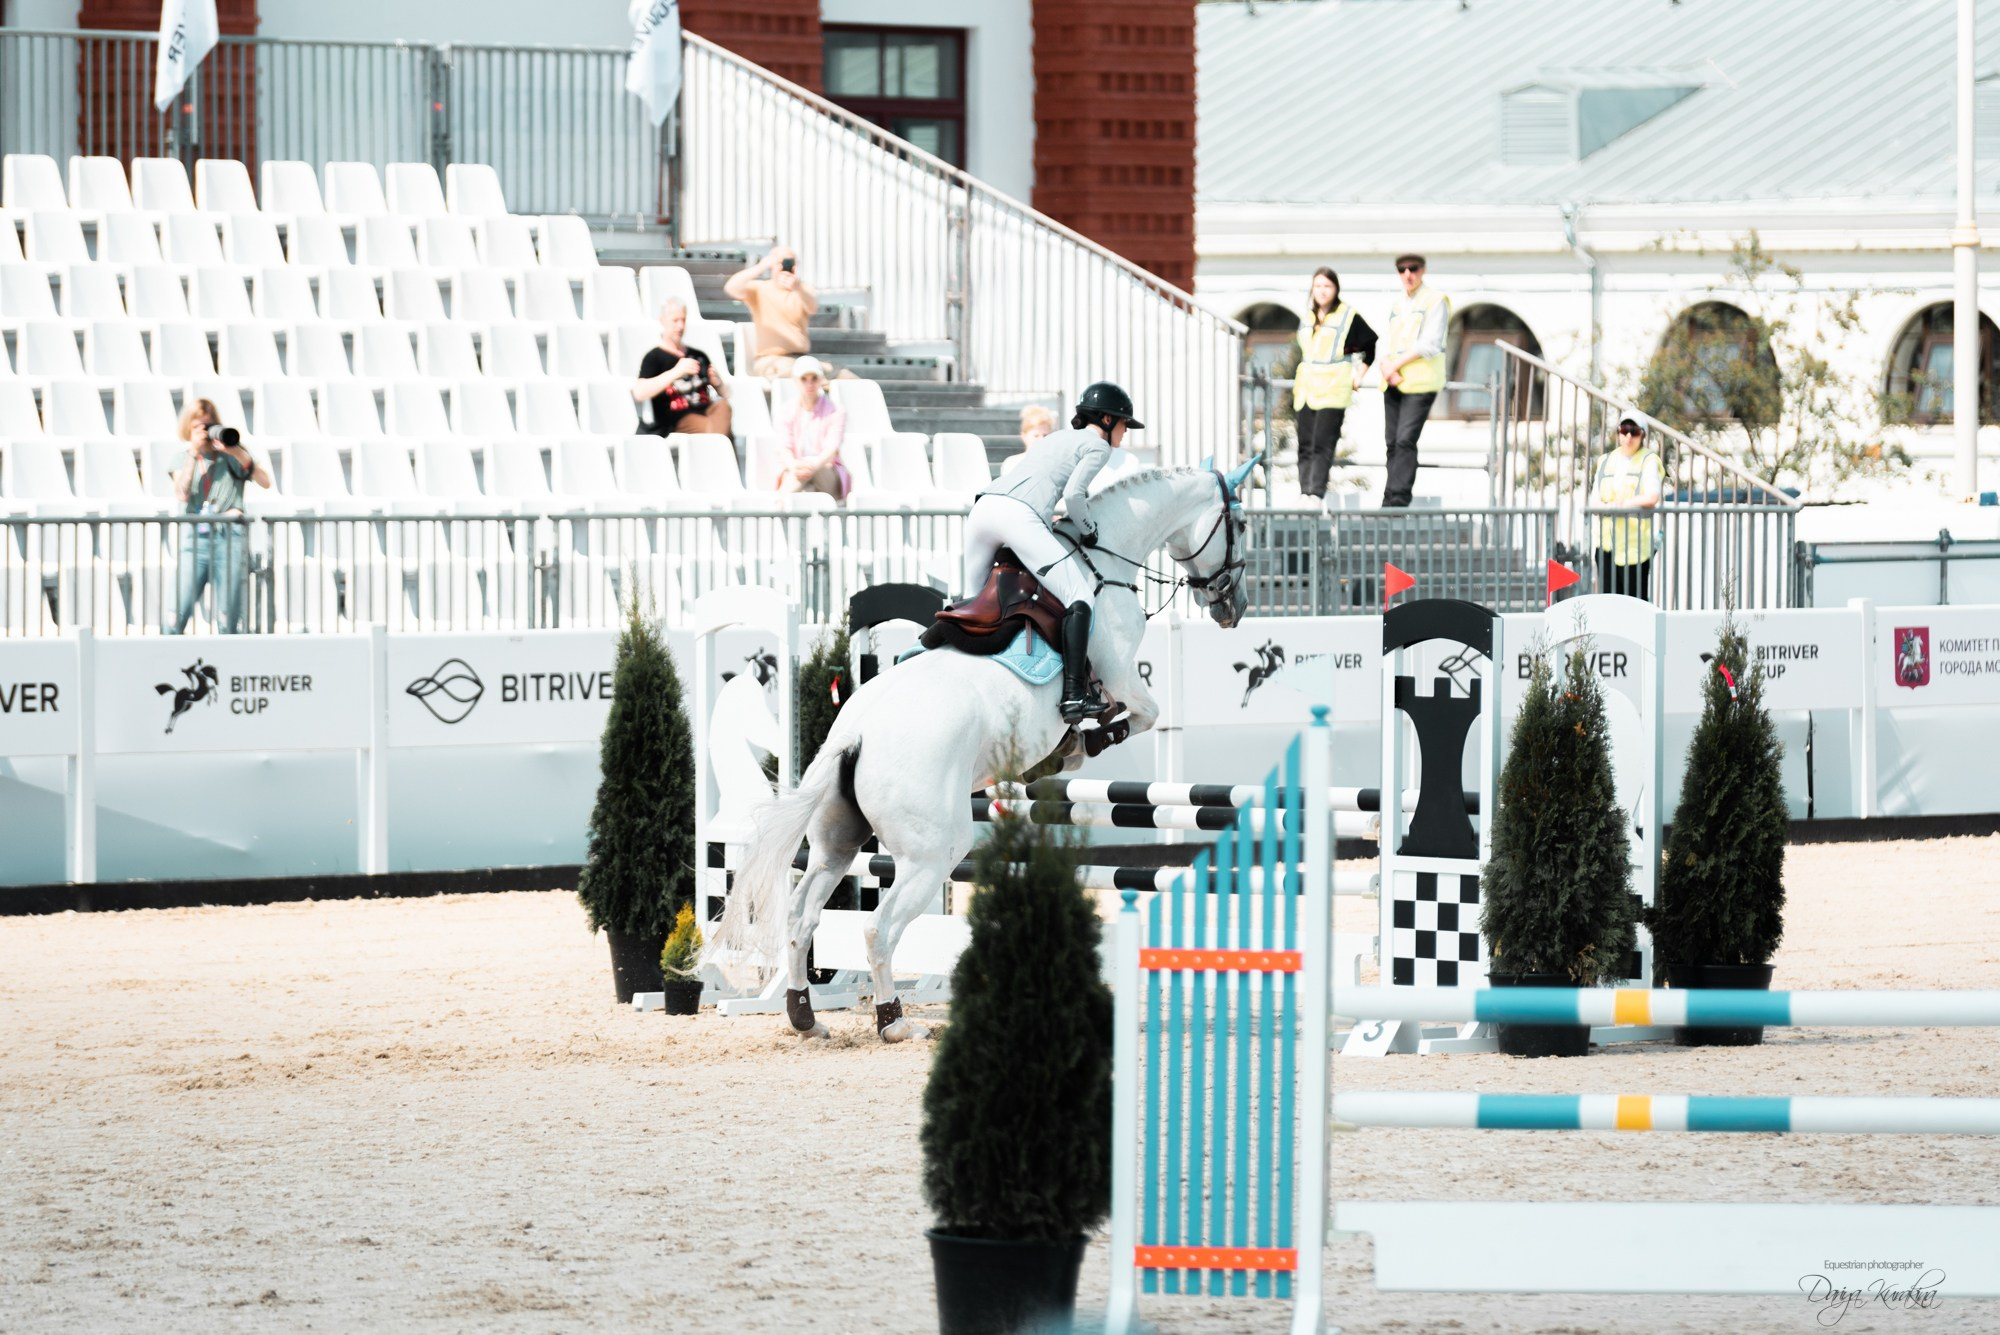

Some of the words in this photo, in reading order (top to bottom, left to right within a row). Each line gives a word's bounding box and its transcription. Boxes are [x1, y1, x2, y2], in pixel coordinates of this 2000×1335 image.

[1757, 644, 1819, 661] BITRIVER
[1939, 638, 1989, 653] КОМИТЕТ
[1939, 660, 1982, 676] ГОРОДА
[230, 674, 313, 693] BITRIVER
[501, 671, 613, 702] BITRIVE
[230, 697, 270, 715] CUP
